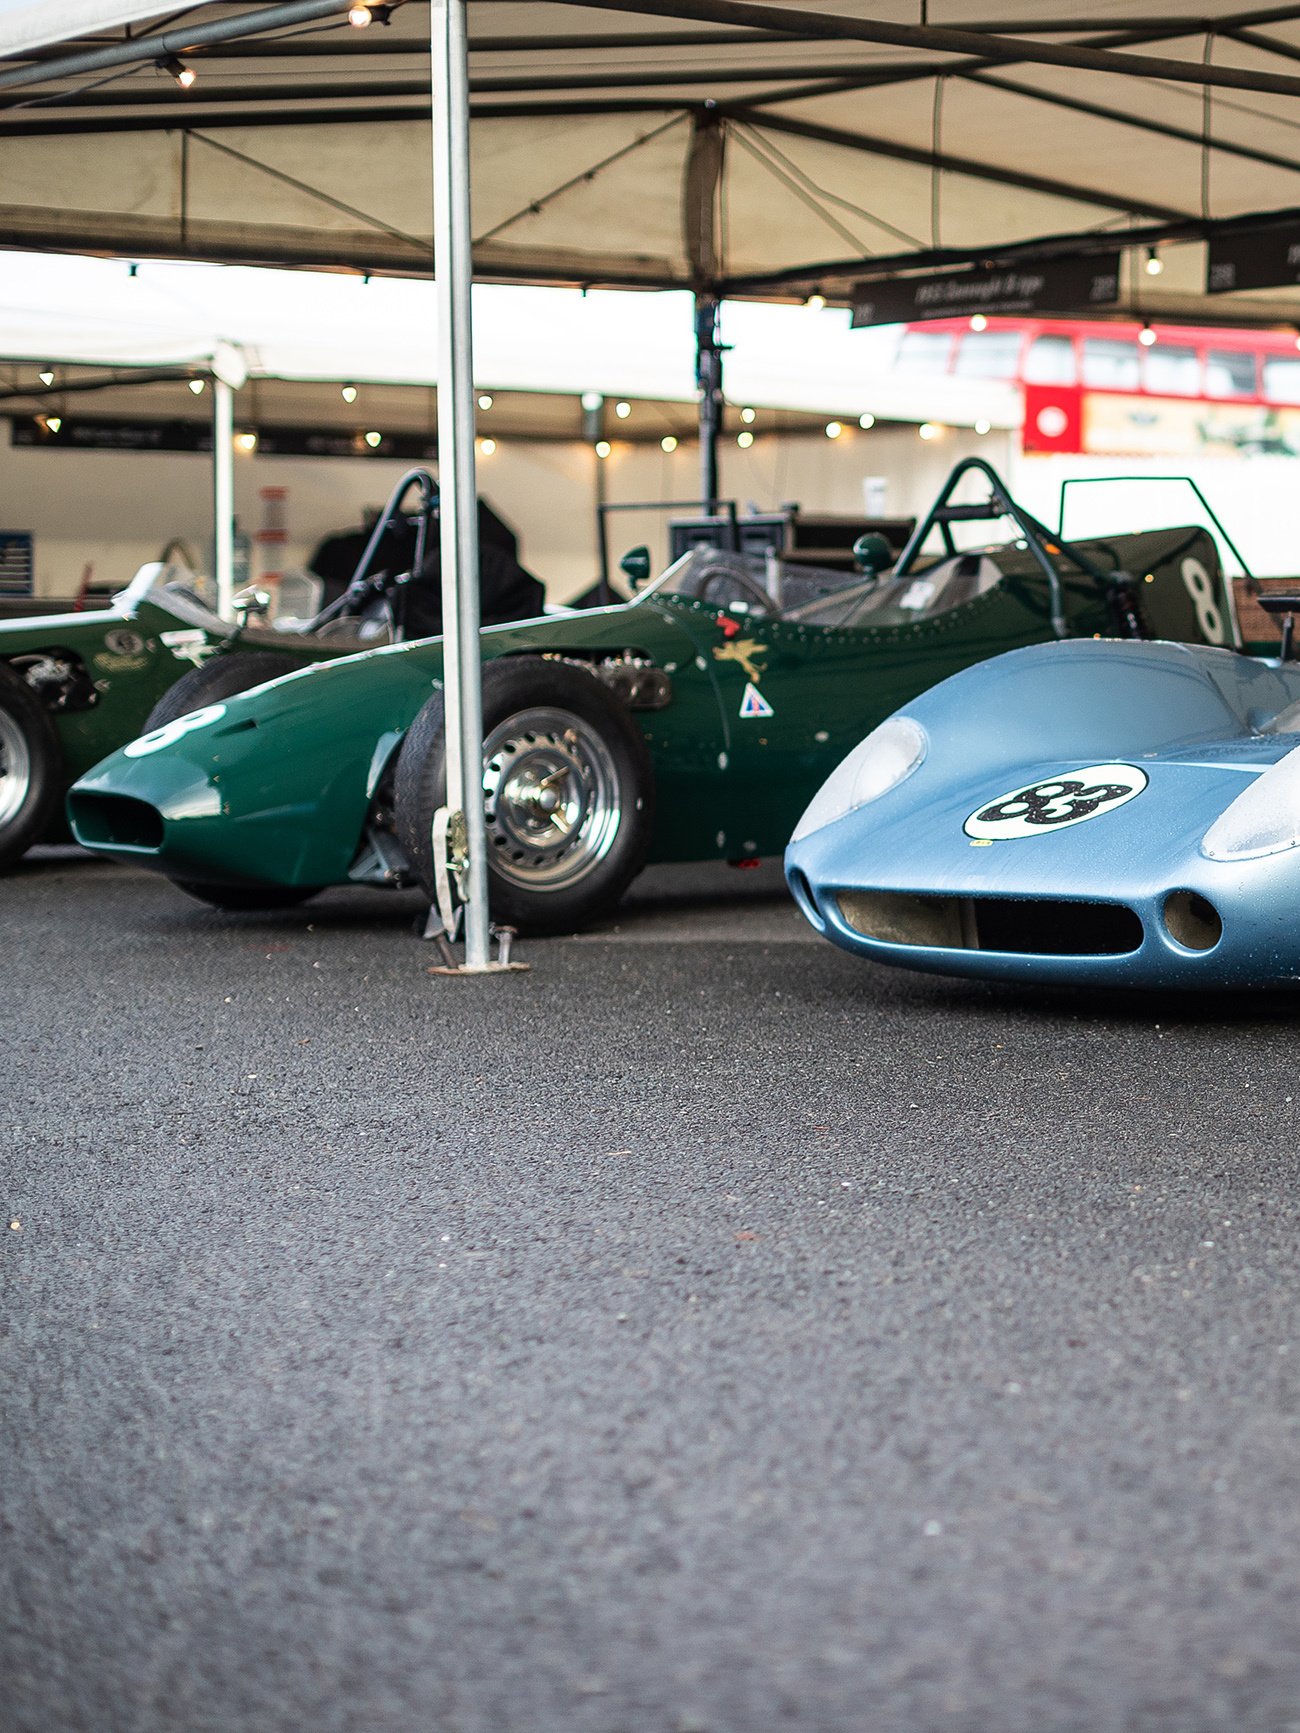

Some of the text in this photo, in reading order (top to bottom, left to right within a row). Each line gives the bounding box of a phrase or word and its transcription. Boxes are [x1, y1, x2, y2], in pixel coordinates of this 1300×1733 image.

[1181, 557, 1225, 645] 8
[123, 703, 227, 759] 8
[976, 780, 1133, 825] 83
